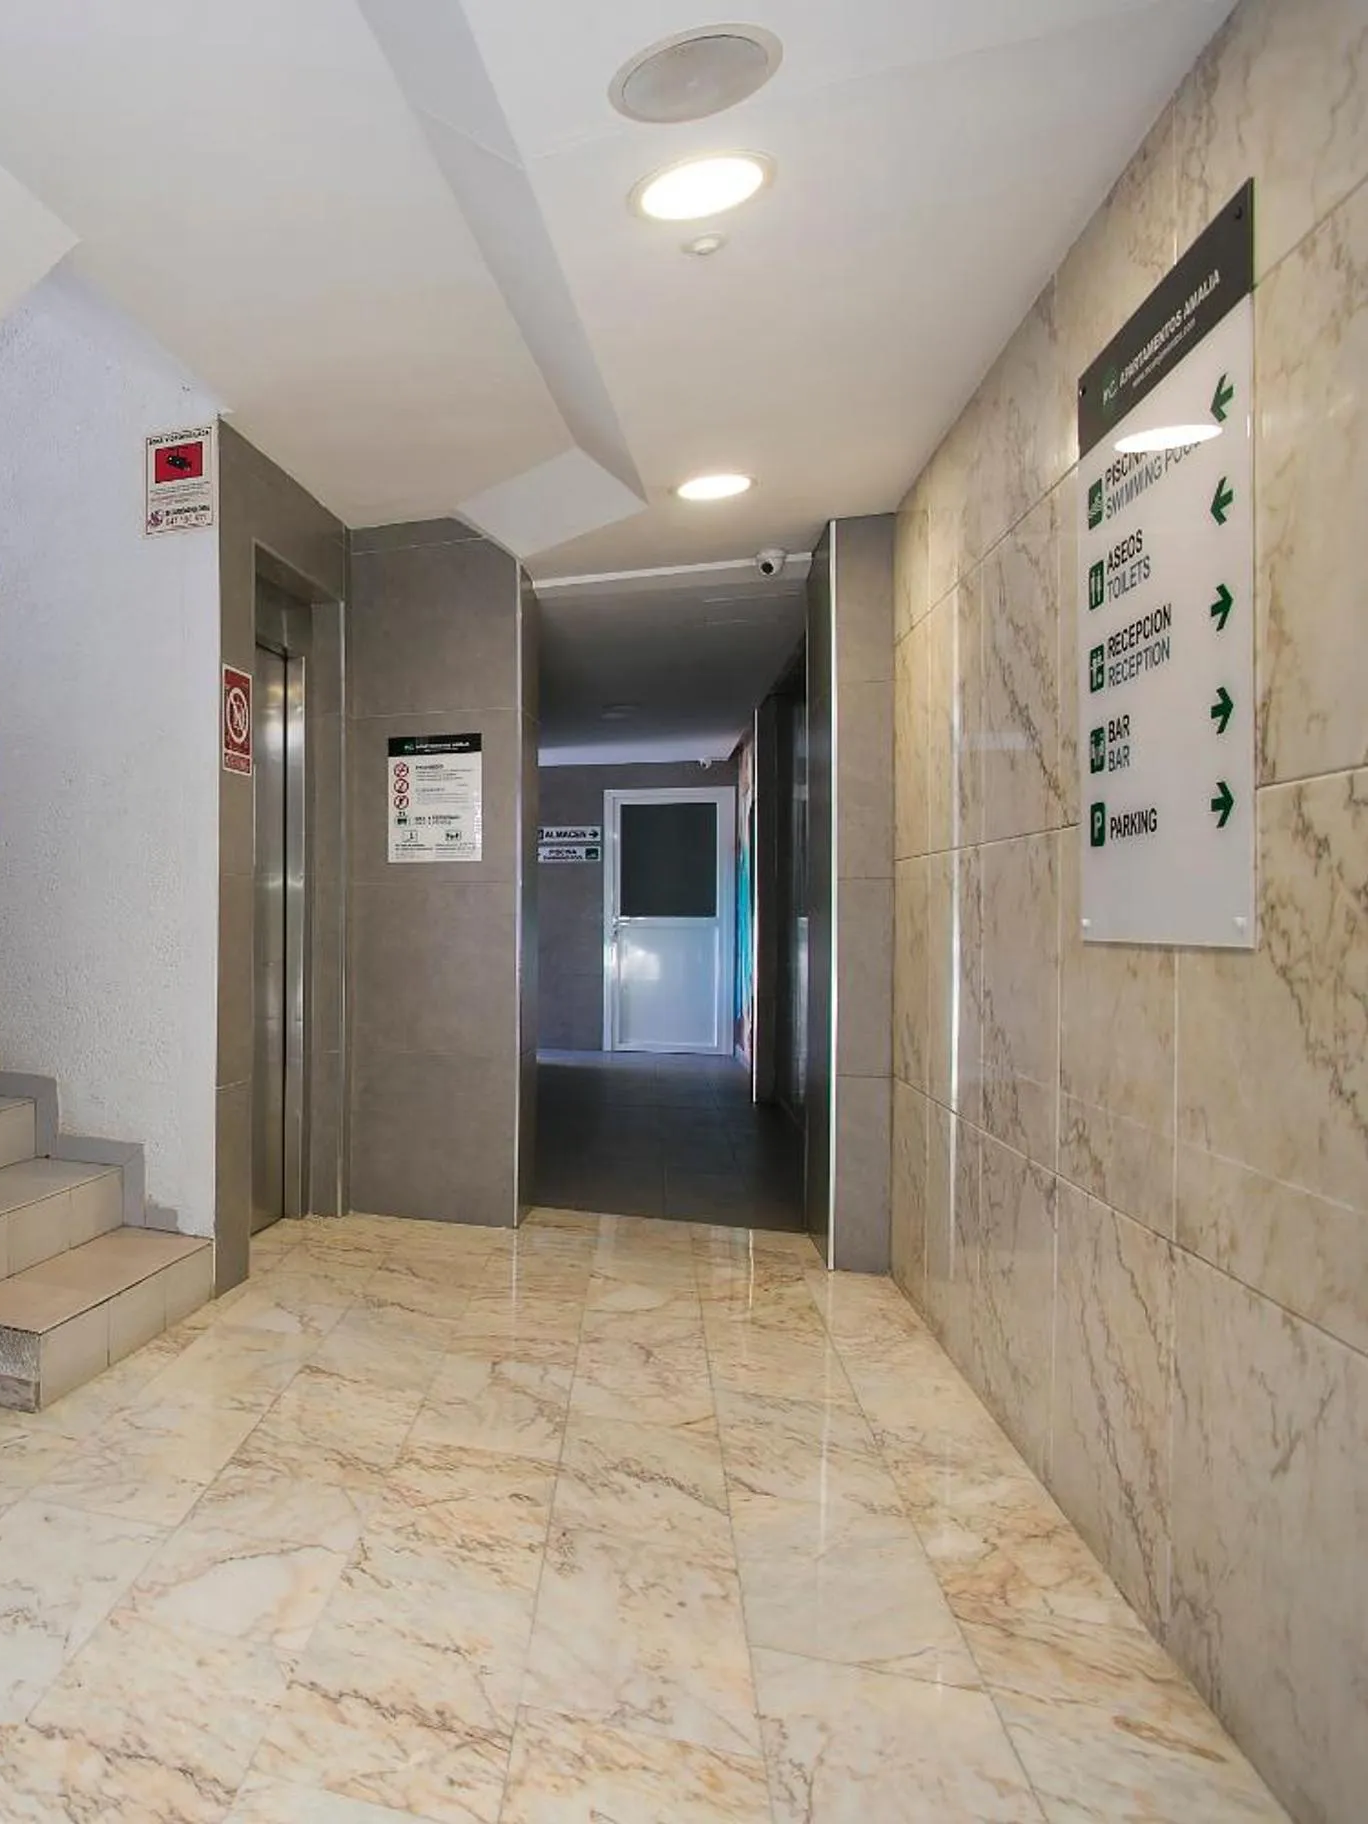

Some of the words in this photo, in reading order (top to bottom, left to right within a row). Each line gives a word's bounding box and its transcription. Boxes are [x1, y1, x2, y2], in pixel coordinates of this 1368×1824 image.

[1119, 309, 1183, 388] APARTAMENTOS
[1183, 269, 1221, 320] AMALIA
[1104, 455, 1163, 520] SWIMMING
[1165, 442, 1200, 472] POO
[1107, 529, 1143, 574] ASEOS
[1107, 555, 1151, 602] TOILETS
[1107, 602, 1172, 659] RECEPCION
[1108, 636, 1170, 688] RECEPTION
[1108, 714, 1130, 743] BAR
[1108, 745, 1130, 772] BAR
[1110, 807, 1157, 840] PARKING
